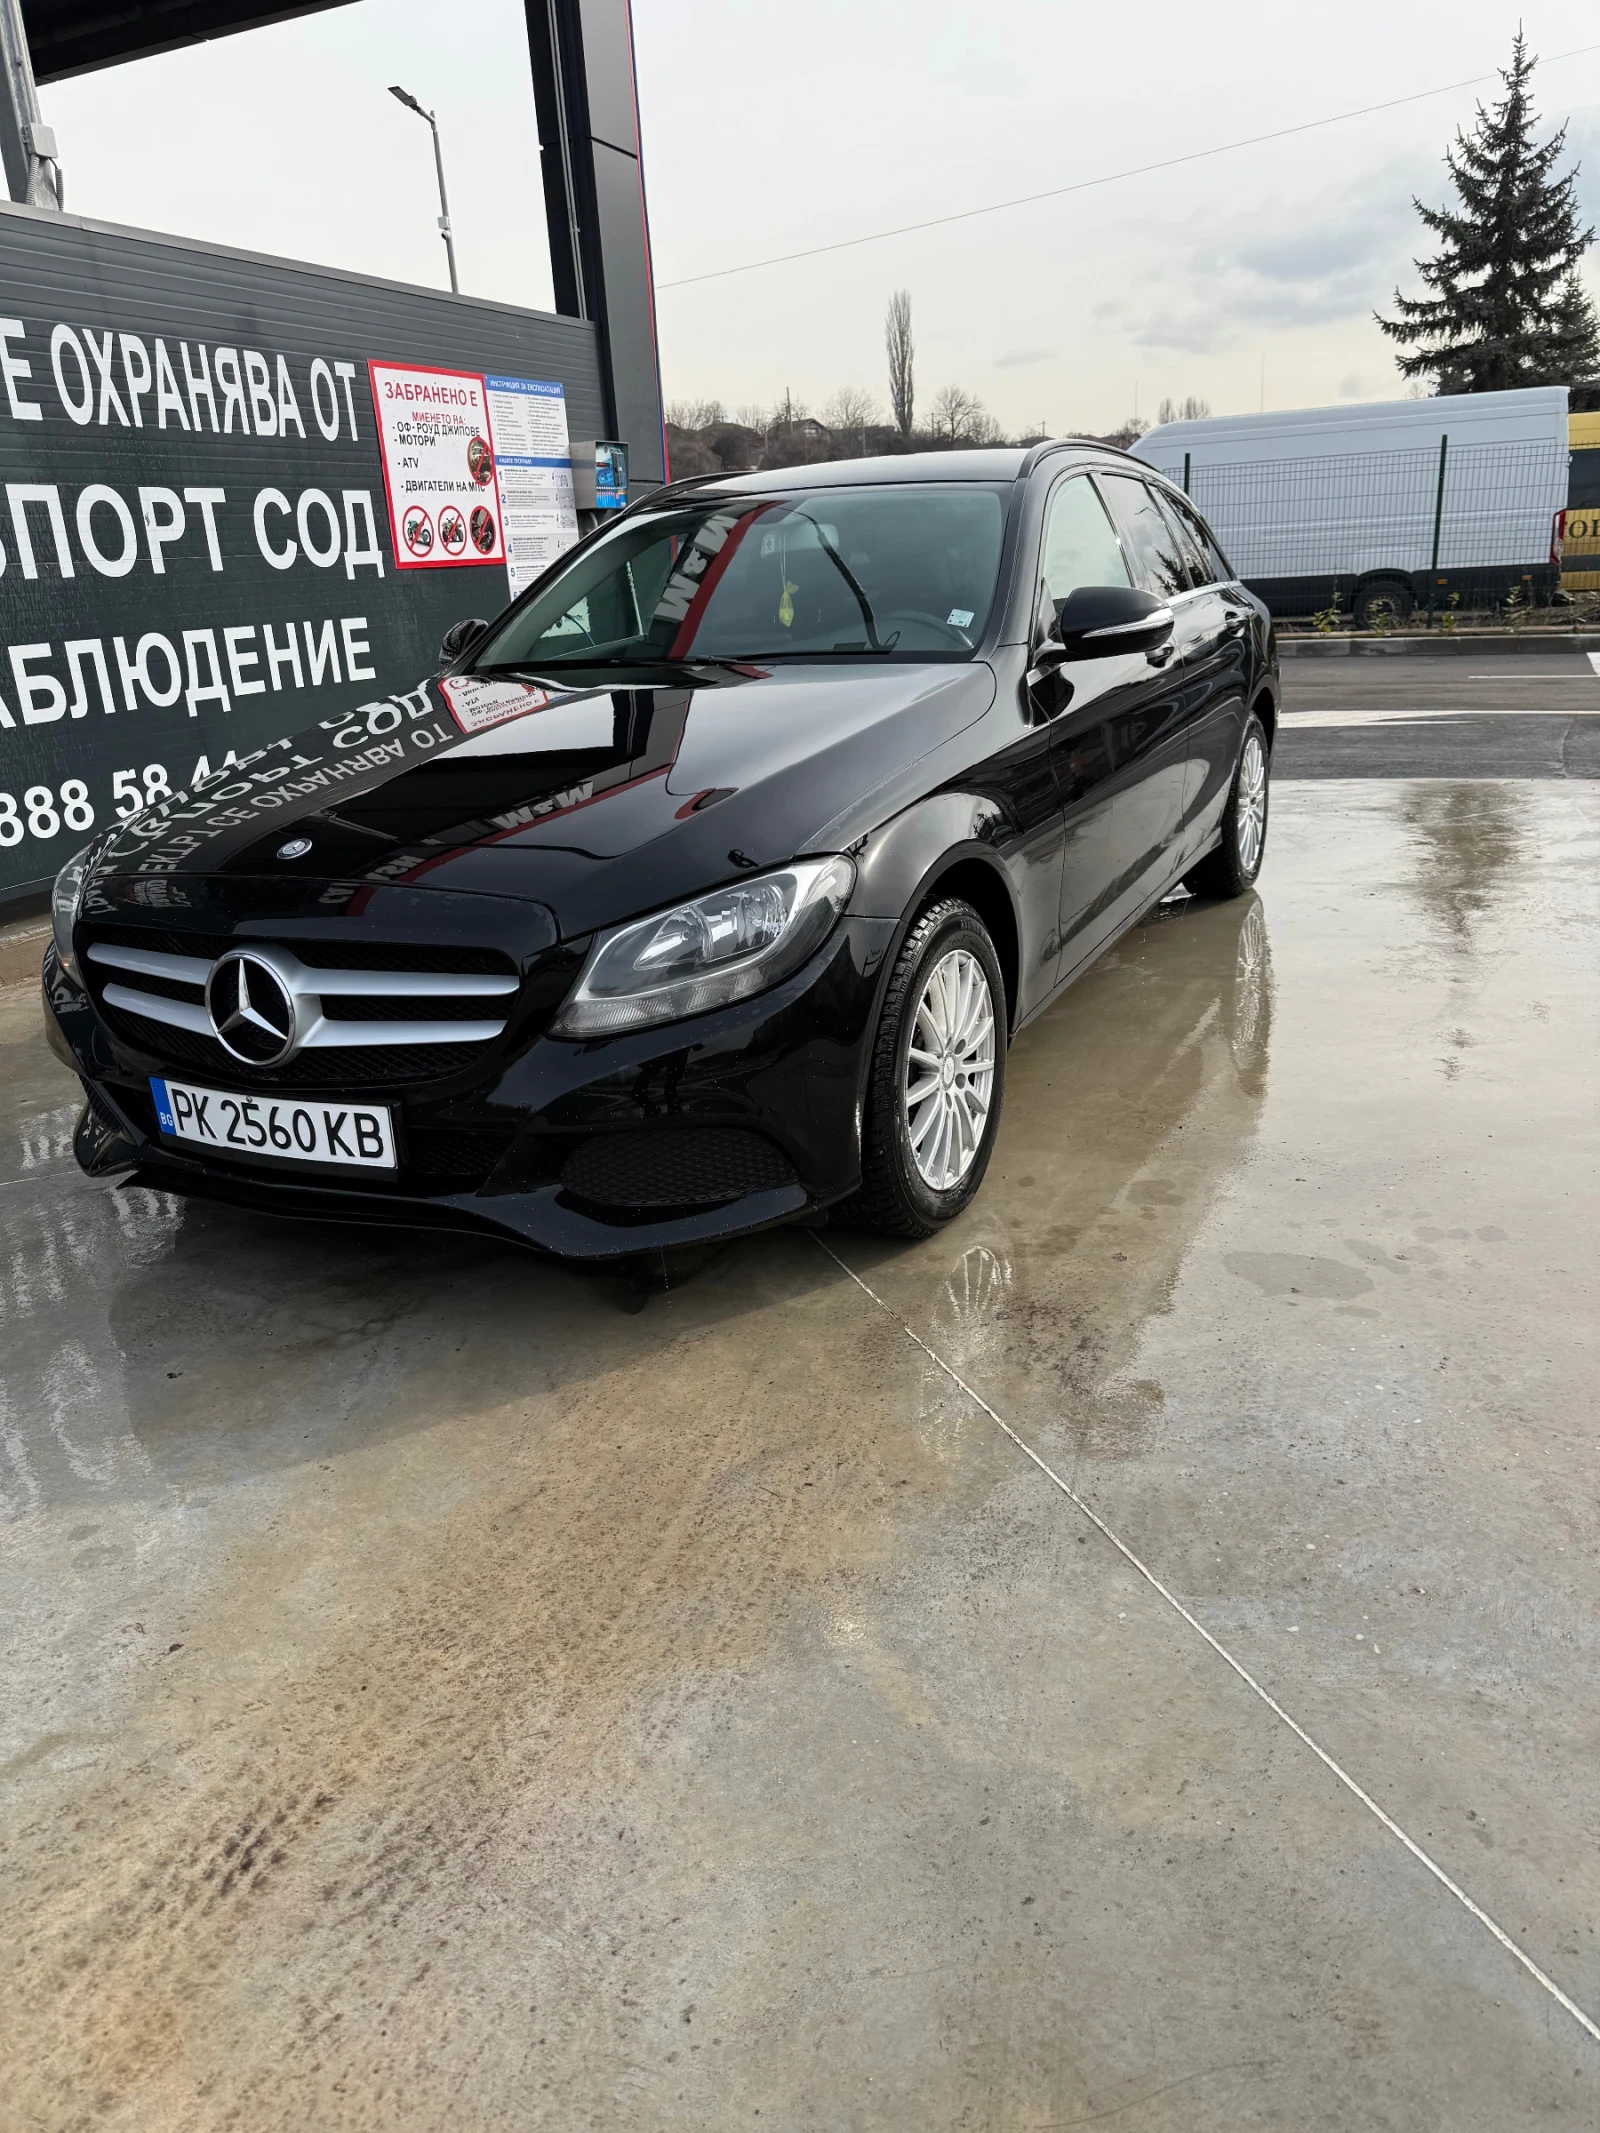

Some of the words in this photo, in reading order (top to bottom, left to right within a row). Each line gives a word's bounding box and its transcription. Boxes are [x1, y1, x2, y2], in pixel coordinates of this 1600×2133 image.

[51, 324, 307, 439] ОХРАНЯВА
[310, 357, 358, 442] ОТ
[384, 381, 467, 406] ЗАБРАНЕНО
[470, 390, 478, 407] Е
[411, 411, 452, 424] МИЕНЕТО
[441, 424, 481, 437] ДЖИПОВЕ
[398, 434, 436, 447] МОТОРИ
[402, 457, 419, 469] ATV
[405, 480, 454, 493] ДВИГАТЕЛИ
[456, 481, 468, 492] НА
[501, 494, 507, 504] 2
[503, 516, 509, 526] 3
[253, 487, 385, 580] СОД
[510, 567, 515, 577] 5
[160, 1112, 174, 1127] BG
[171, 1088, 218, 1140] PK
[220, 1100, 316, 1153] 2560
[323, 1110, 384, 1159] KB
